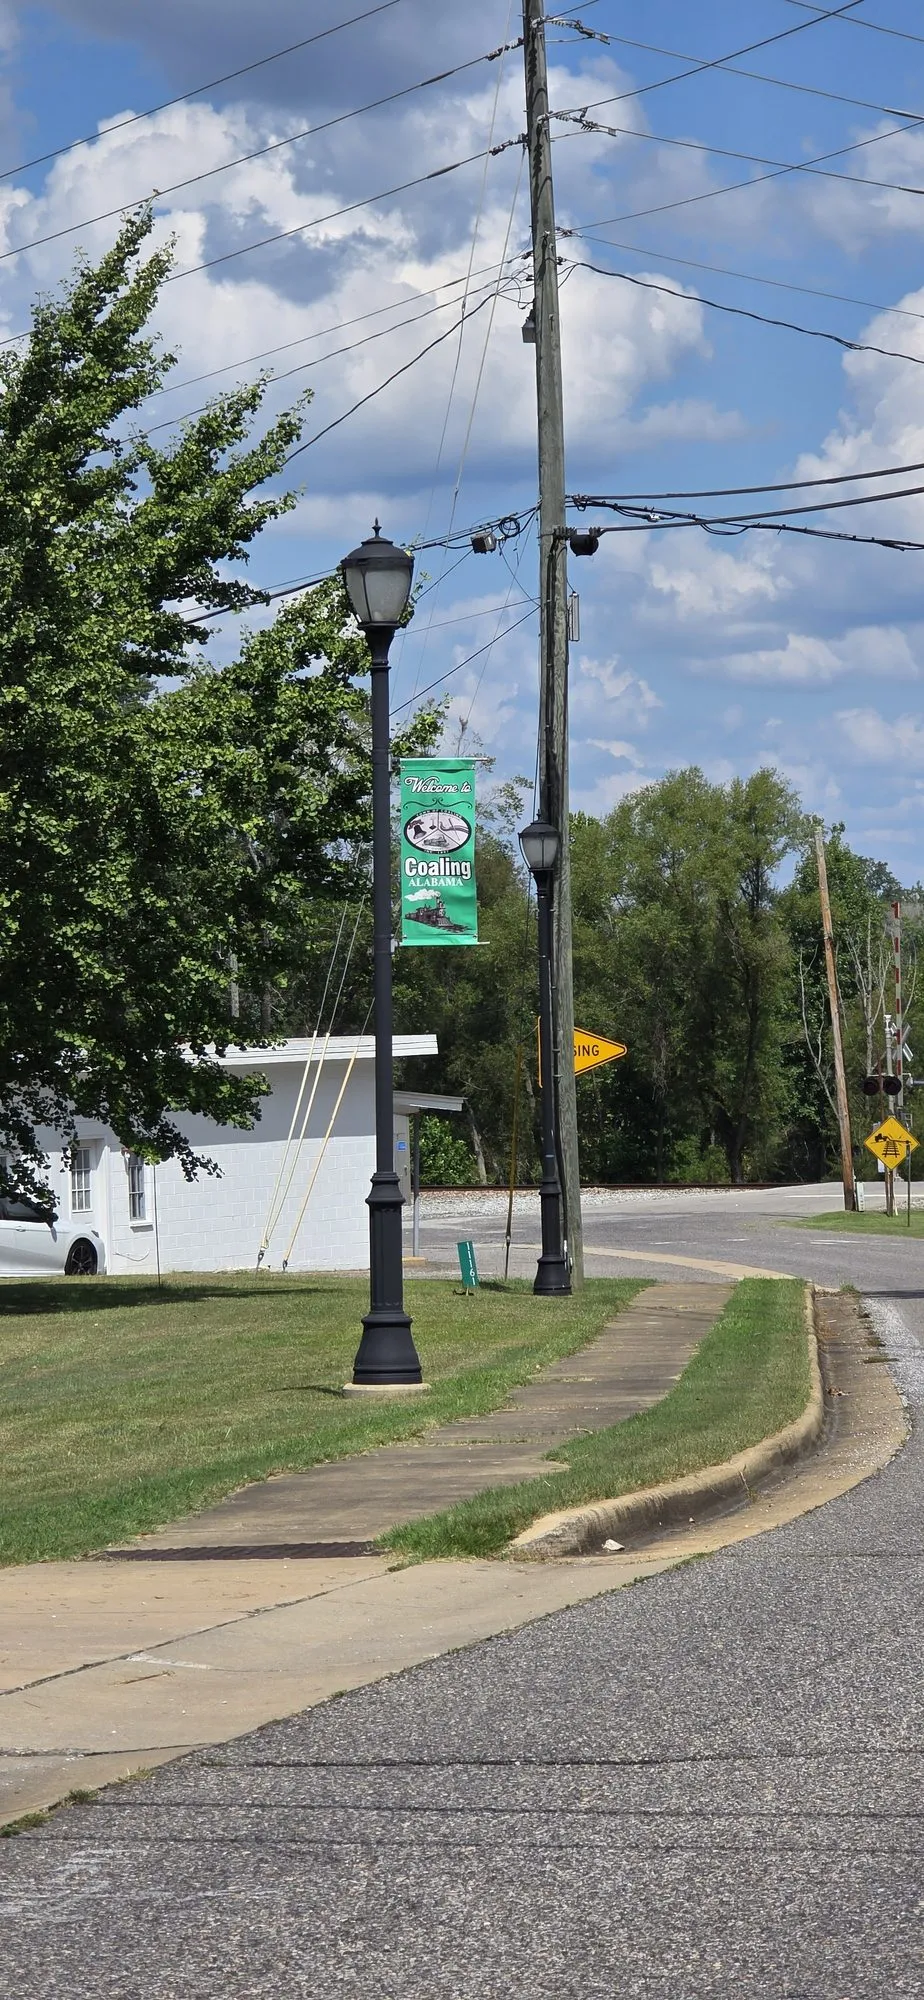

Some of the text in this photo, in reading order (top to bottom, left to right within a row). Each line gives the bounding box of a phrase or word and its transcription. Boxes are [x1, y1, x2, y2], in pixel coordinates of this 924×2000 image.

[404, 776, 472, 793] Welcome to
[405, 857, 471, 879] Coaling
[408, 878, 463, 887] ALABAMA
[466, 1241, 475, 1286] 11161
